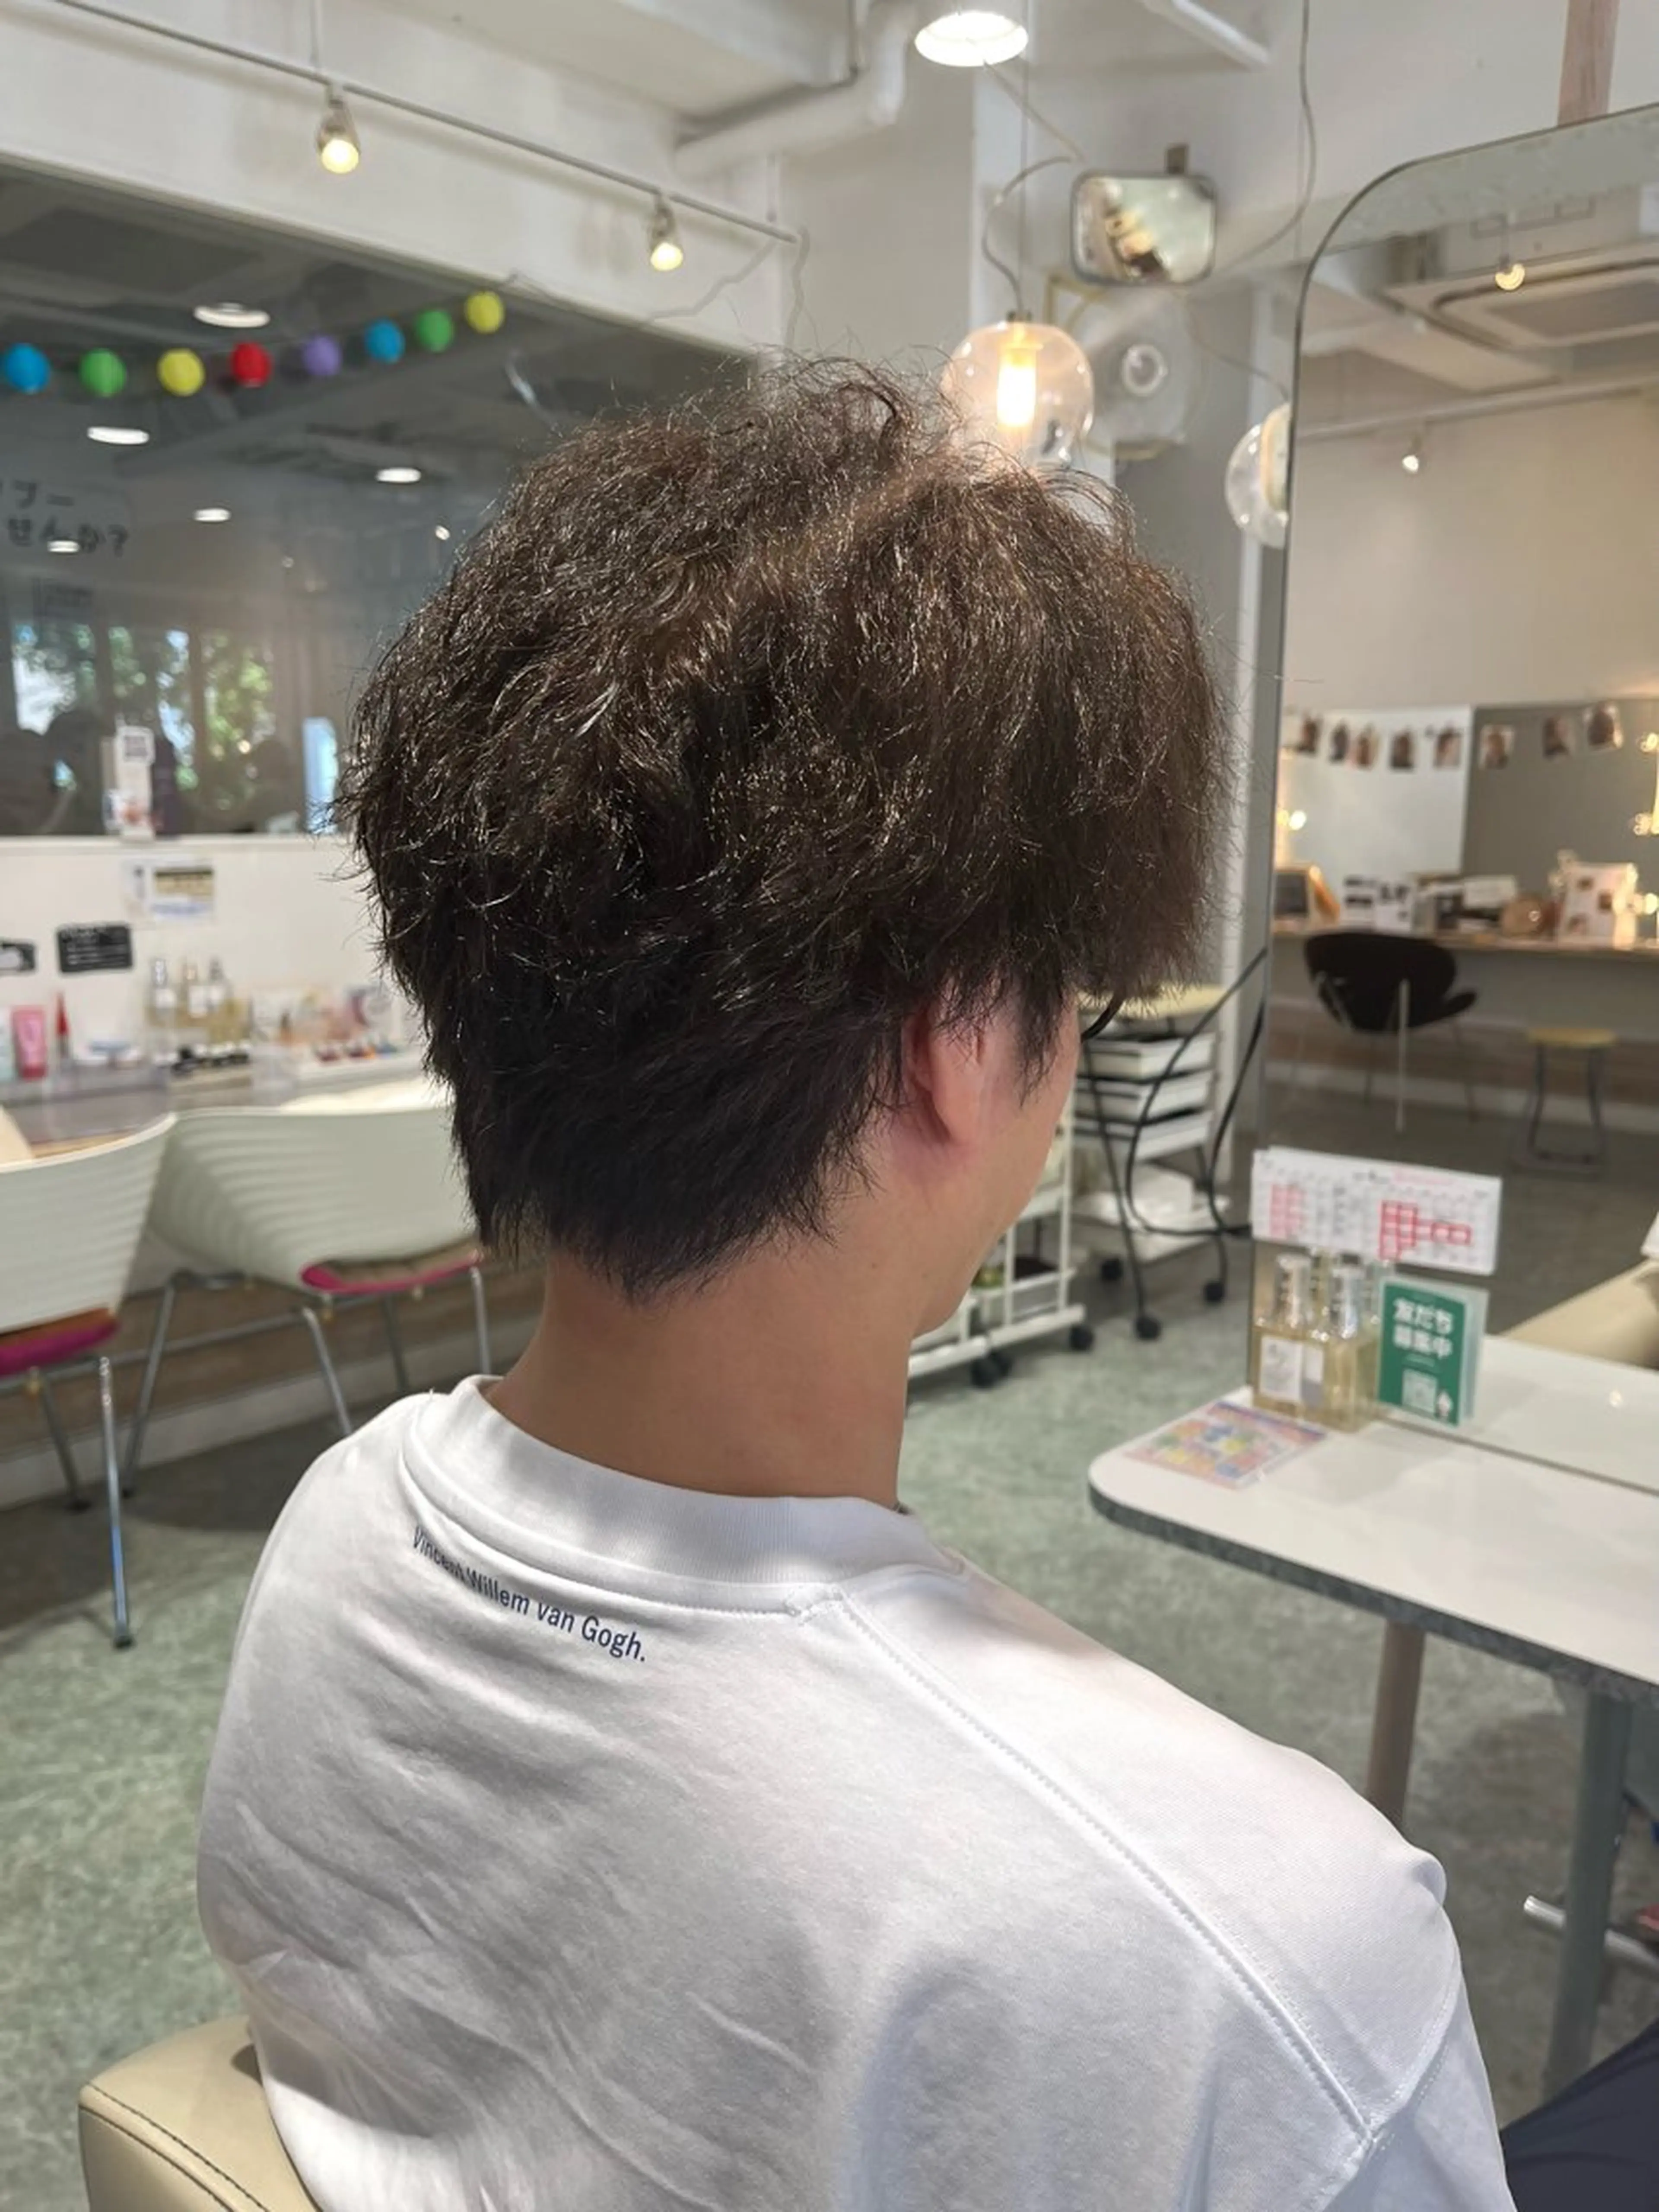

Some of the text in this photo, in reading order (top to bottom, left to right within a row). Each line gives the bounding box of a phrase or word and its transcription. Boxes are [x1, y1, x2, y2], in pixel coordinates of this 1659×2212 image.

[467, 1567, 529, 1615] Willem
[537, 1602, 575, 1633] van
[582, 1615, 645, 1662] Gogh.
